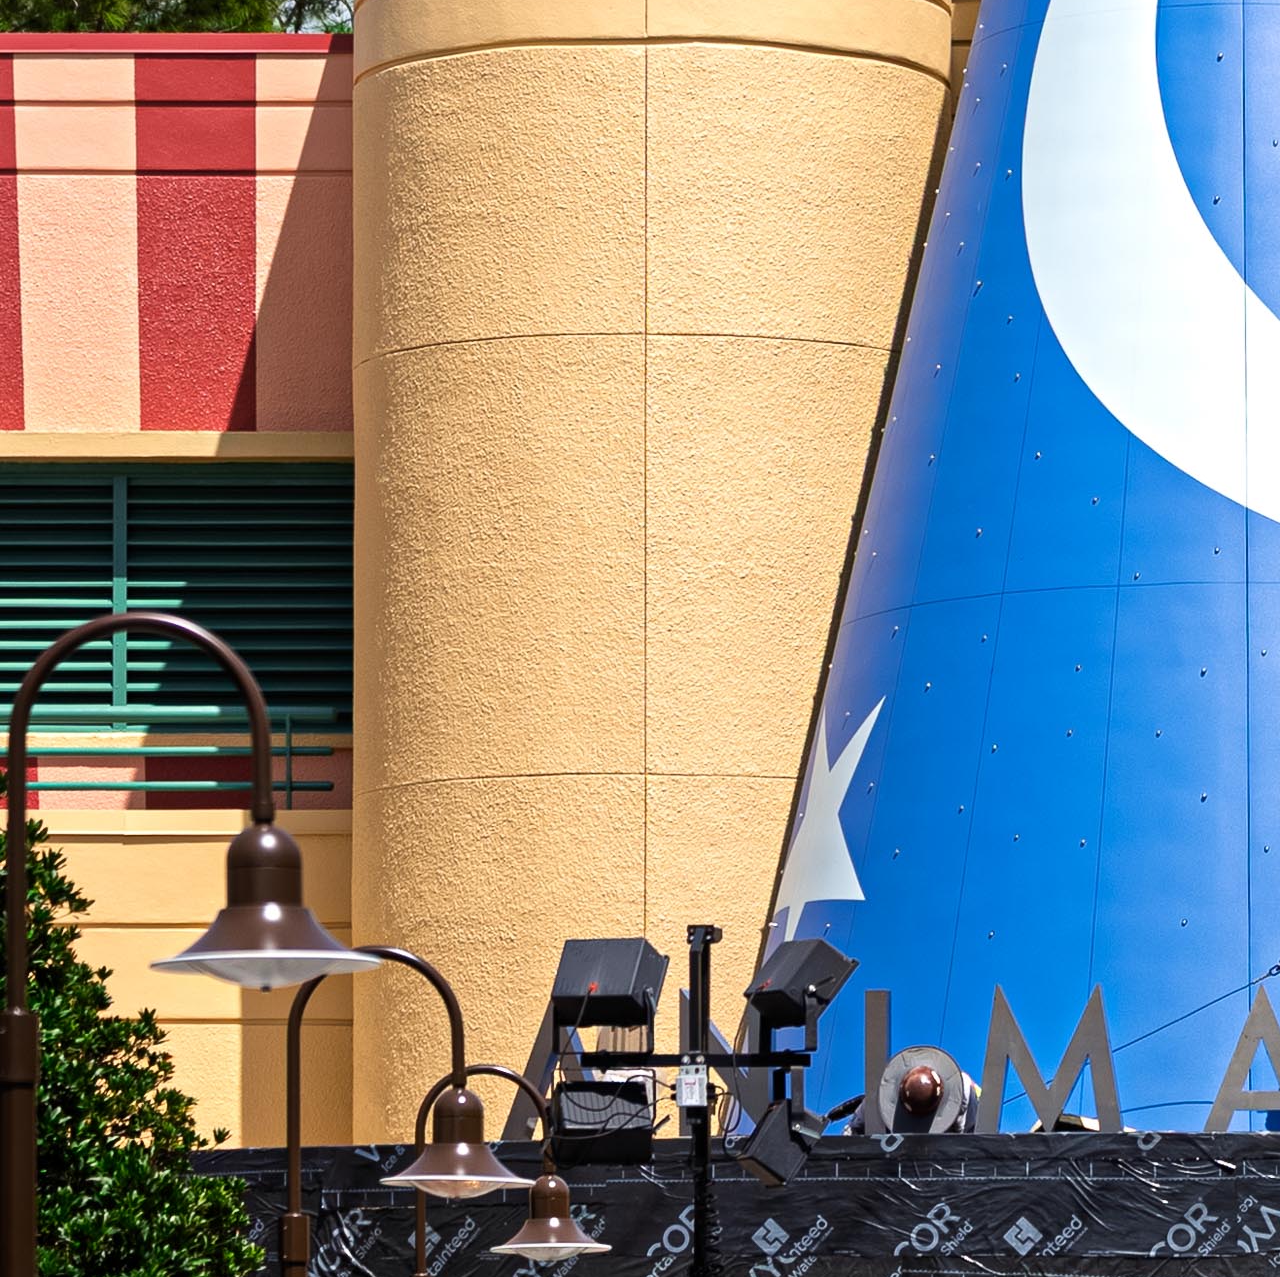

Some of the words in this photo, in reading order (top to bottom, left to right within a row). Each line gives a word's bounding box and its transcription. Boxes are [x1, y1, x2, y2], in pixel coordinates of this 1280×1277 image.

[1238, 1195, 1259, 1214] Ice
[939, 1219, 976, 1257] Shield
[1197, 1219, 1232, 1257] Shield
